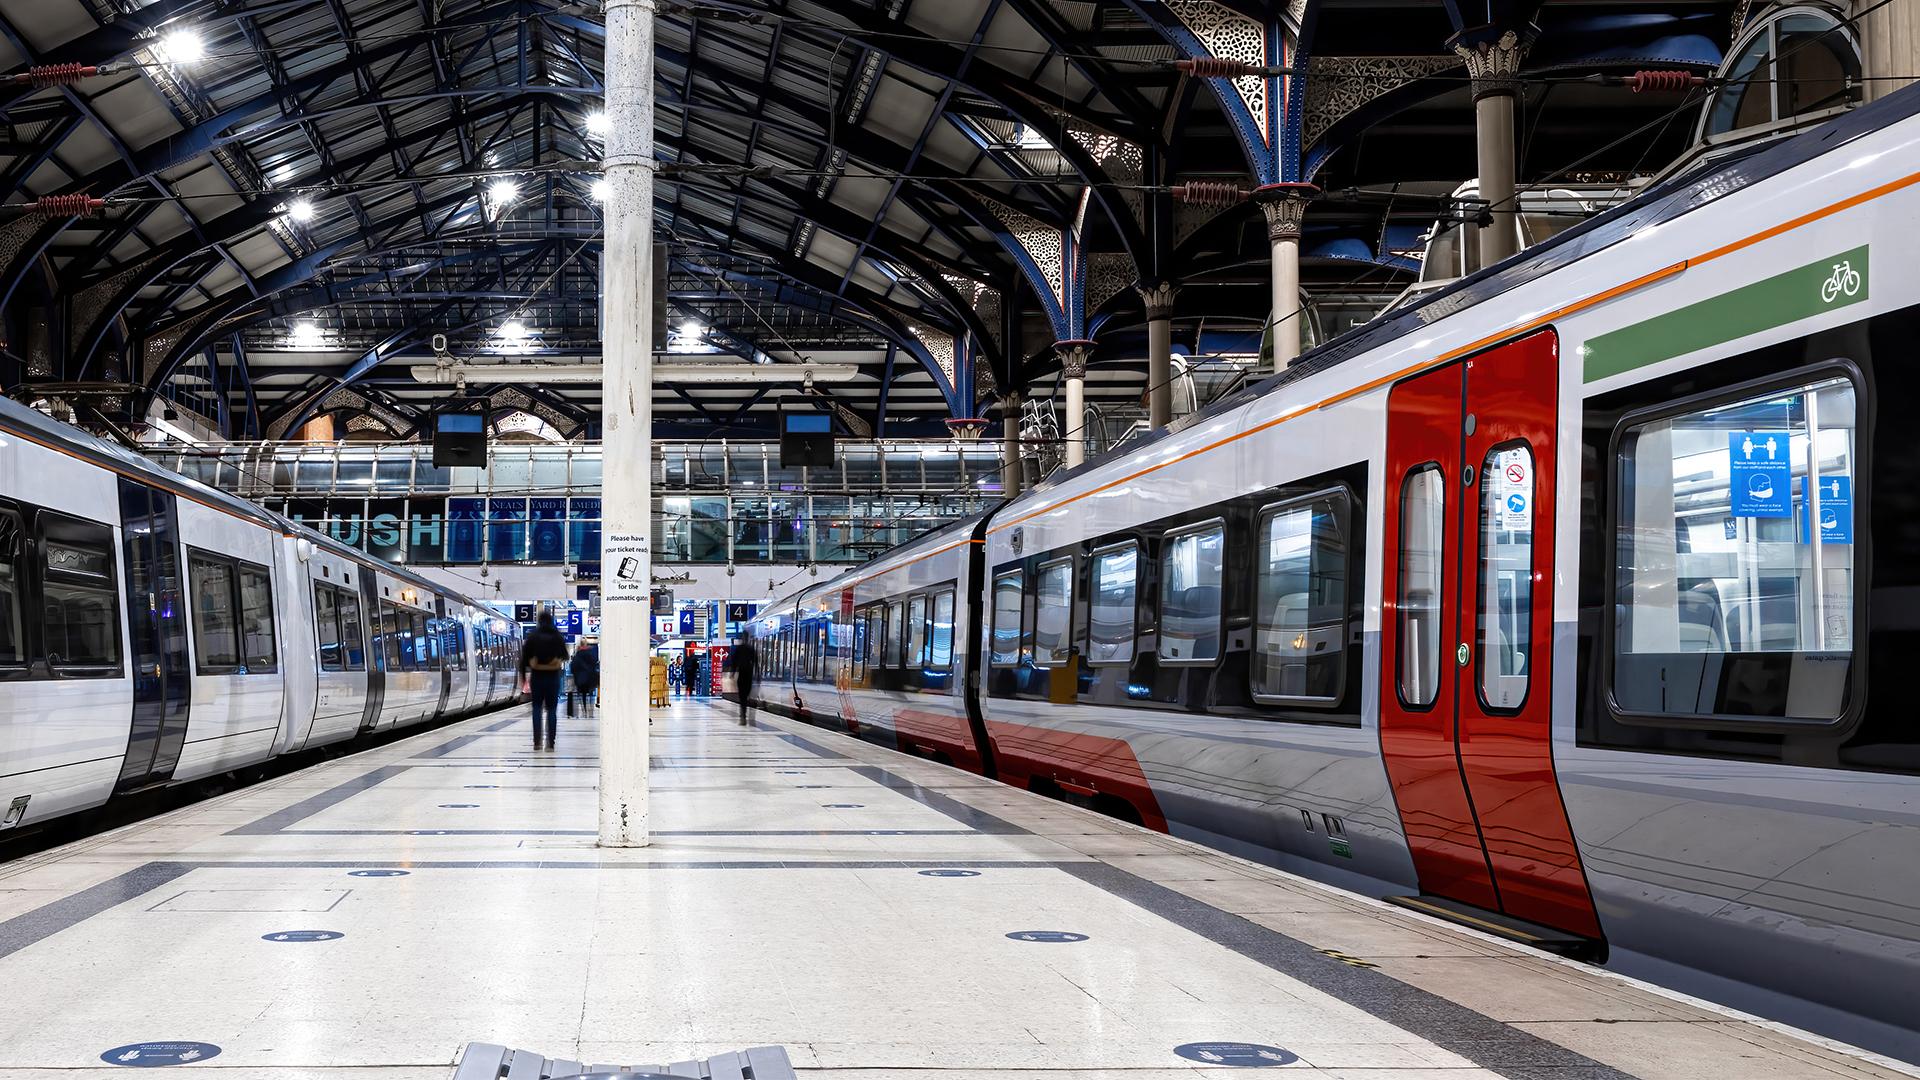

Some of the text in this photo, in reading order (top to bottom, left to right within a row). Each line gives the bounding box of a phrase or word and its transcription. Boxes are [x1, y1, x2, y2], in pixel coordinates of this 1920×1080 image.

[530, 500, 557, 509] YARD
[560, 500, 601, 509] REMEDI
[293, 514, 441, 546] USH
[520, 606, 529, 619] 5
[734, 606, 743, 618] 4
[571, 613, 579, 625] 5
[682, 613, 692, 624] 4
